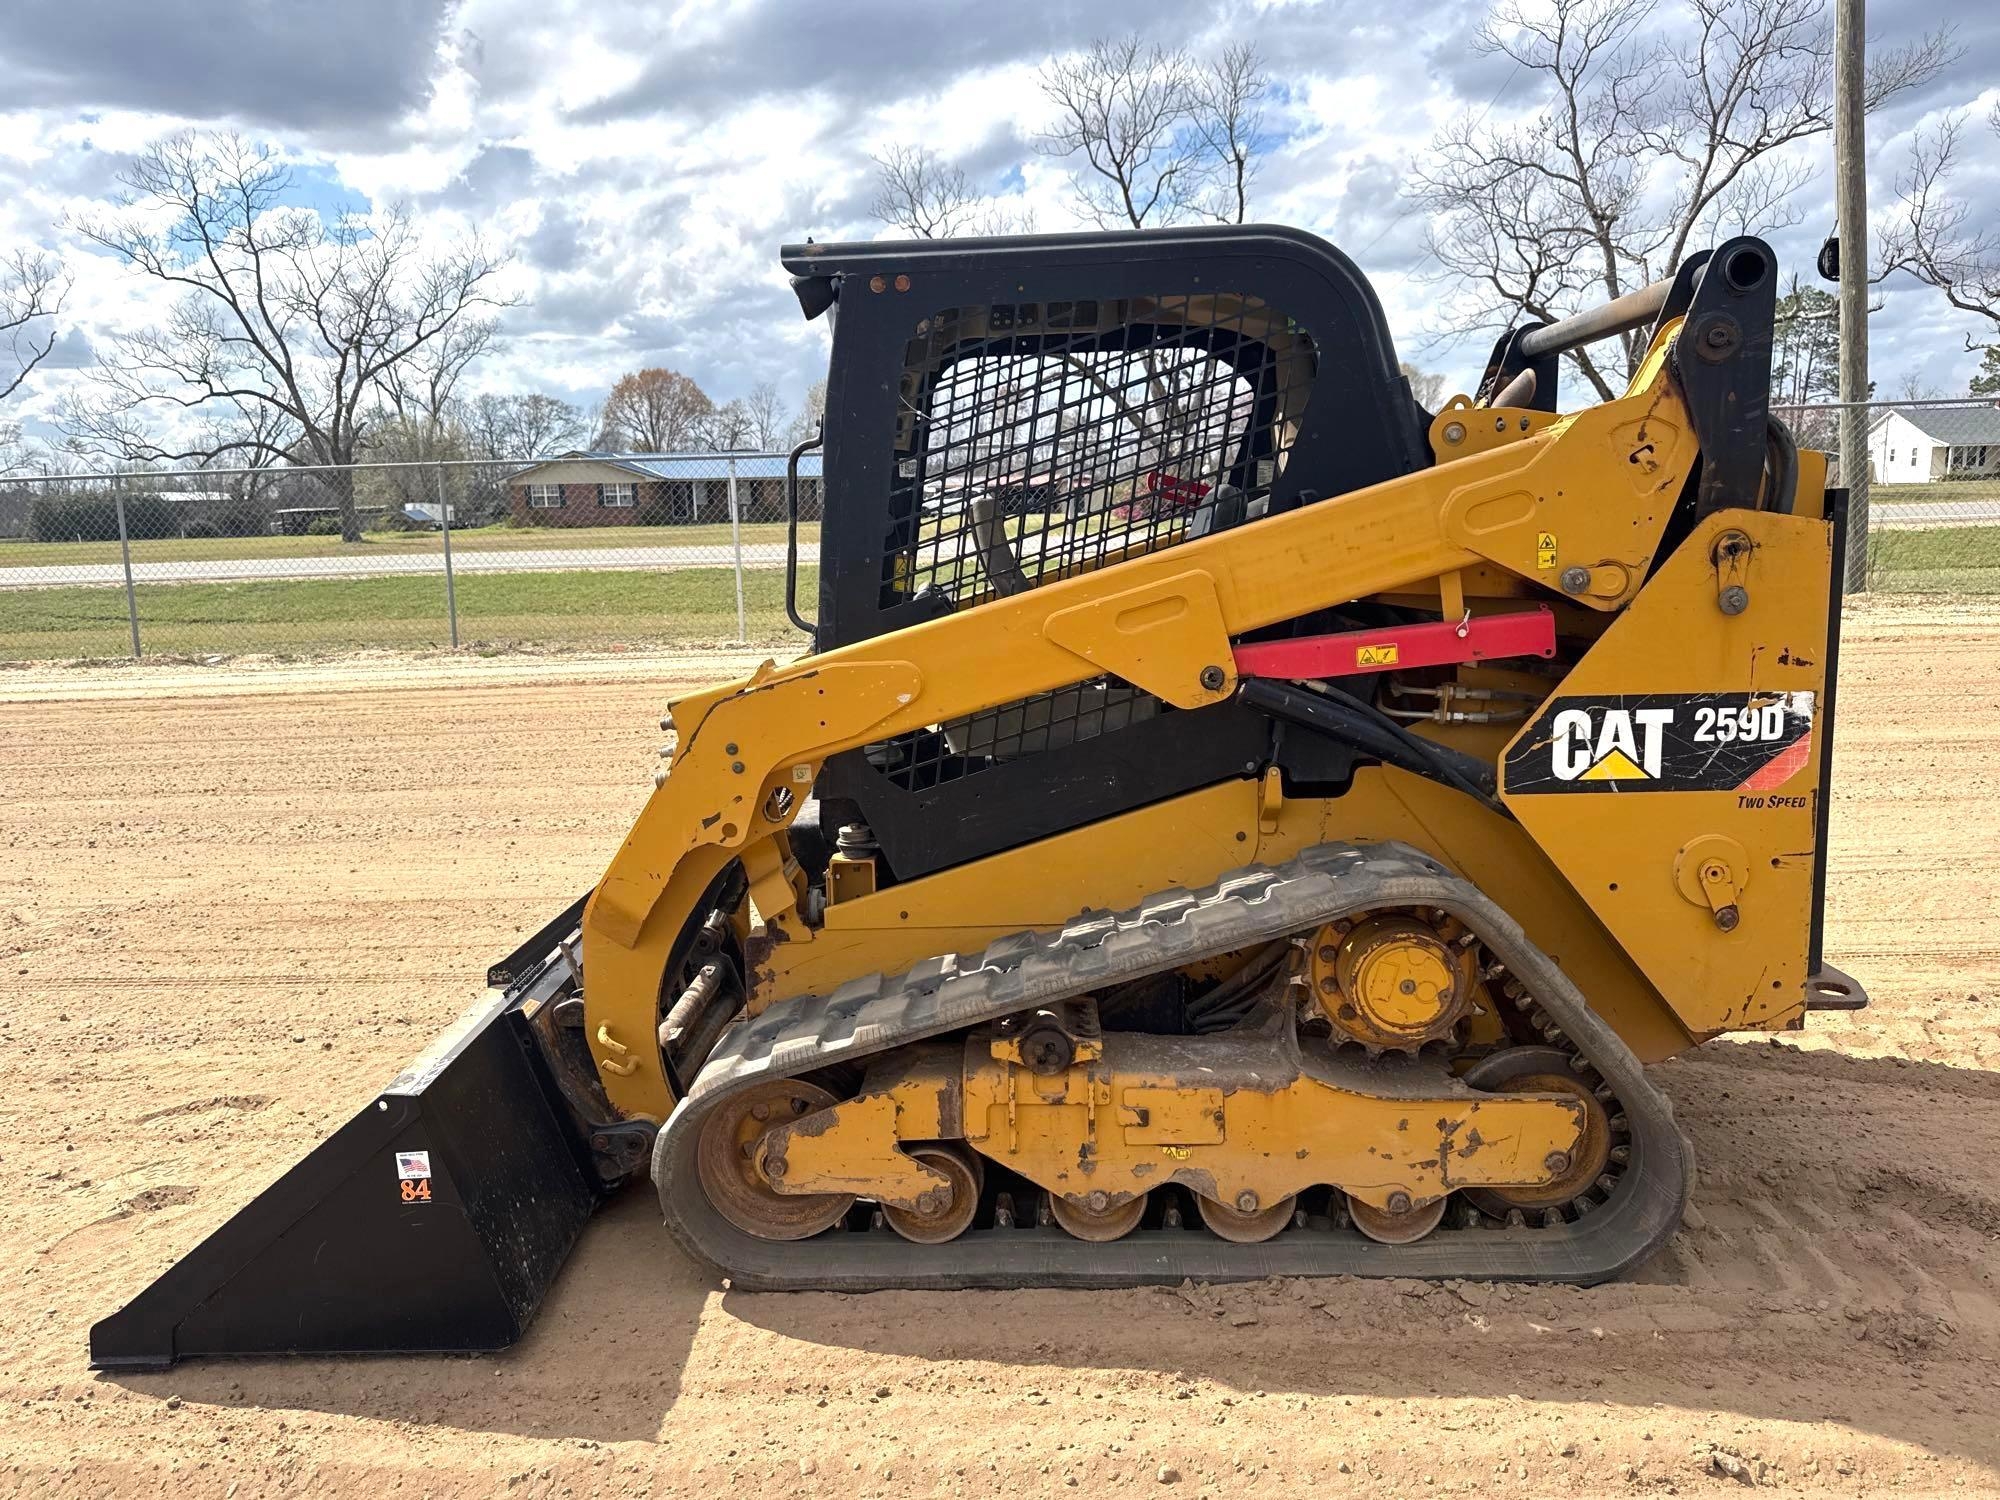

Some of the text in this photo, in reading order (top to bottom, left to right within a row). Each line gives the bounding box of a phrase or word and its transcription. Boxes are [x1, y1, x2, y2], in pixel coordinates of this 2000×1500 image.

[1552, 705, 1786, 781] CAT 259D
[400, 1179, 432, 1201] 84
